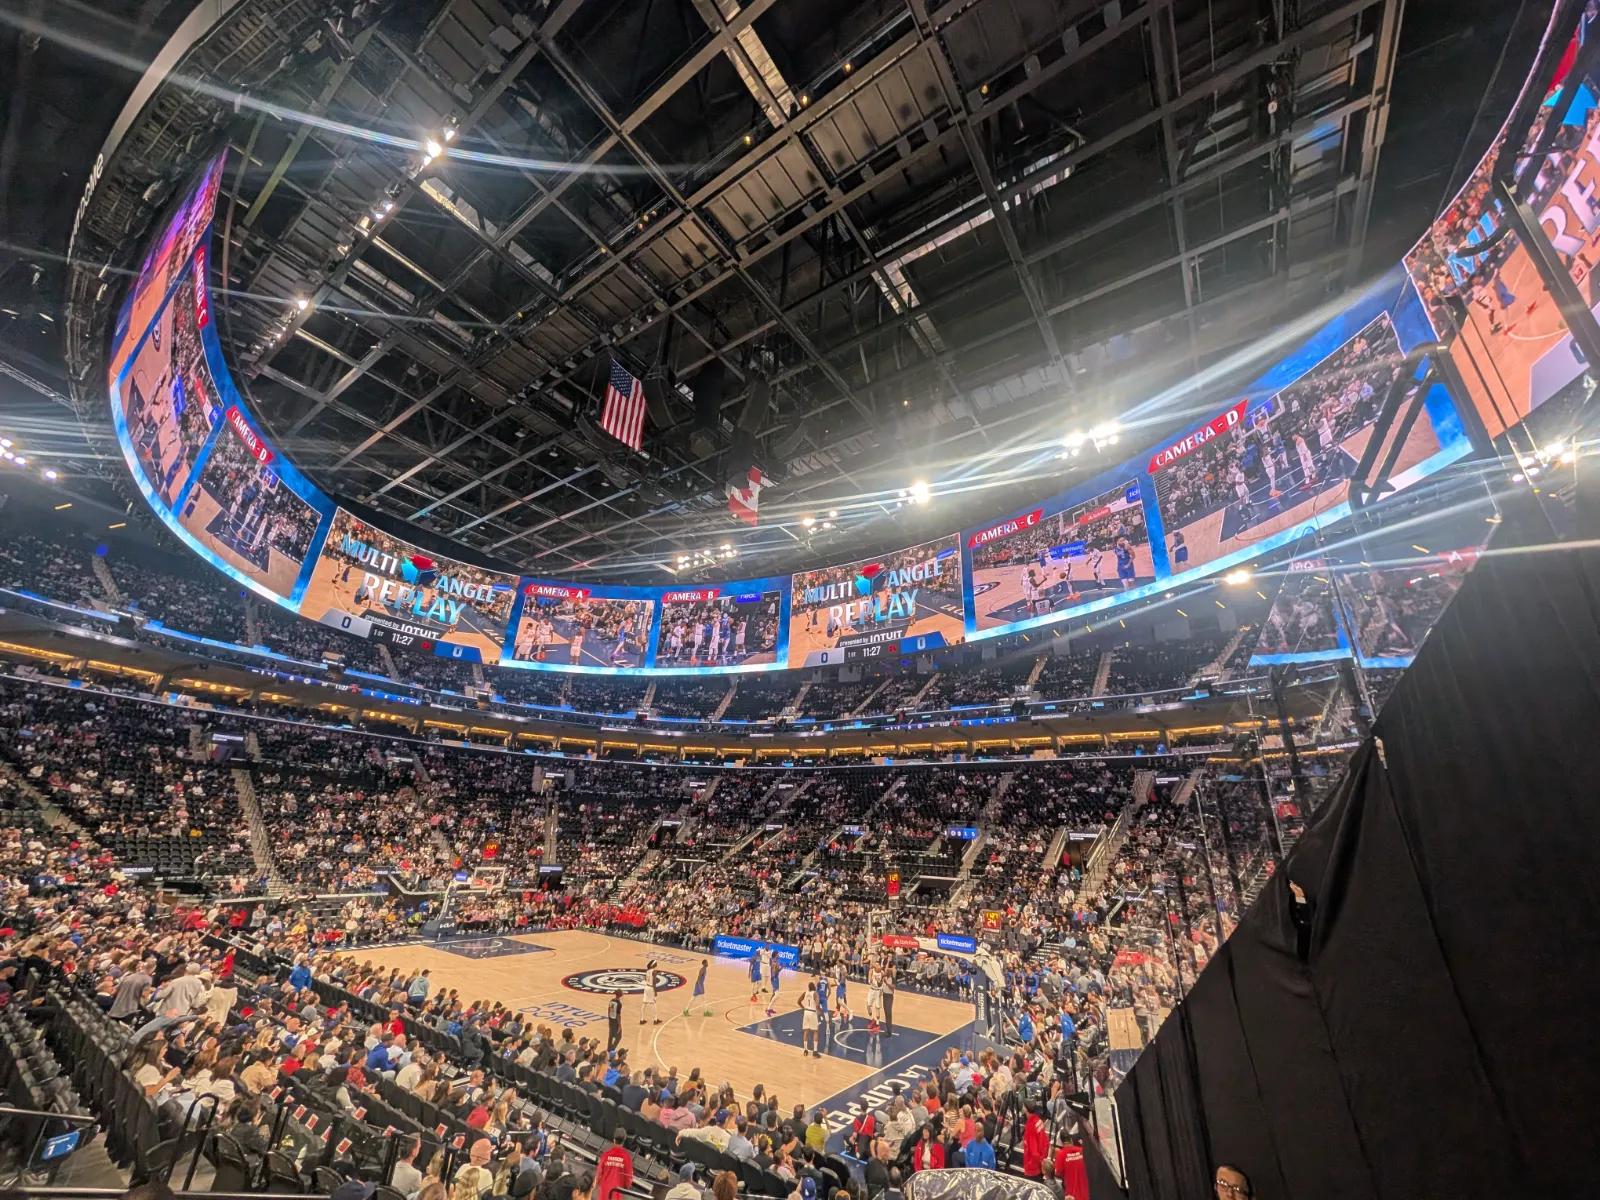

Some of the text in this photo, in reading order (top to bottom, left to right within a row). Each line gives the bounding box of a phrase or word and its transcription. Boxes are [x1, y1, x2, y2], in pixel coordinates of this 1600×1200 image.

[232, 409, 257, 450] CAMERA
[259, 451, 267, 461] D
[1156, 427, 1215, 466] CAMERA
[1226, 410, 1239, 425] D
[974, 522, 1018, 544] CAMERA
[1027, 514, 1035, 525] C
[341, 534, 496, 603] MULTI ANGLE
[803, 560, 944, 604] MULTI ANGLE
[358, 572, 466, 625] REPLAY
[532, 586, 569, 598] CAMERA
[576, 589, 583, 599] A
[667, 591, 701, 600] CAMERA
[707, 591, 713, 599] B
[828, 589, 919, 627] REPLAY
[341, 616, 352, 628] 0
[365, 614, 392, 628] presented
[400, 624, 440, 639] INTUIT
[392, 633, 414, 646] 11:27
[870, 630, 903, 643] INTUIT
[917, 637, 926, 650] 0
[452, 646, 462, 657] 0
[820, 652, 828, 663] 0
[862, 646, 881, 657] 11:27
[717, 939, 752, 952] ticketmaster
[940, 938, 973, 948] ticketmaster
